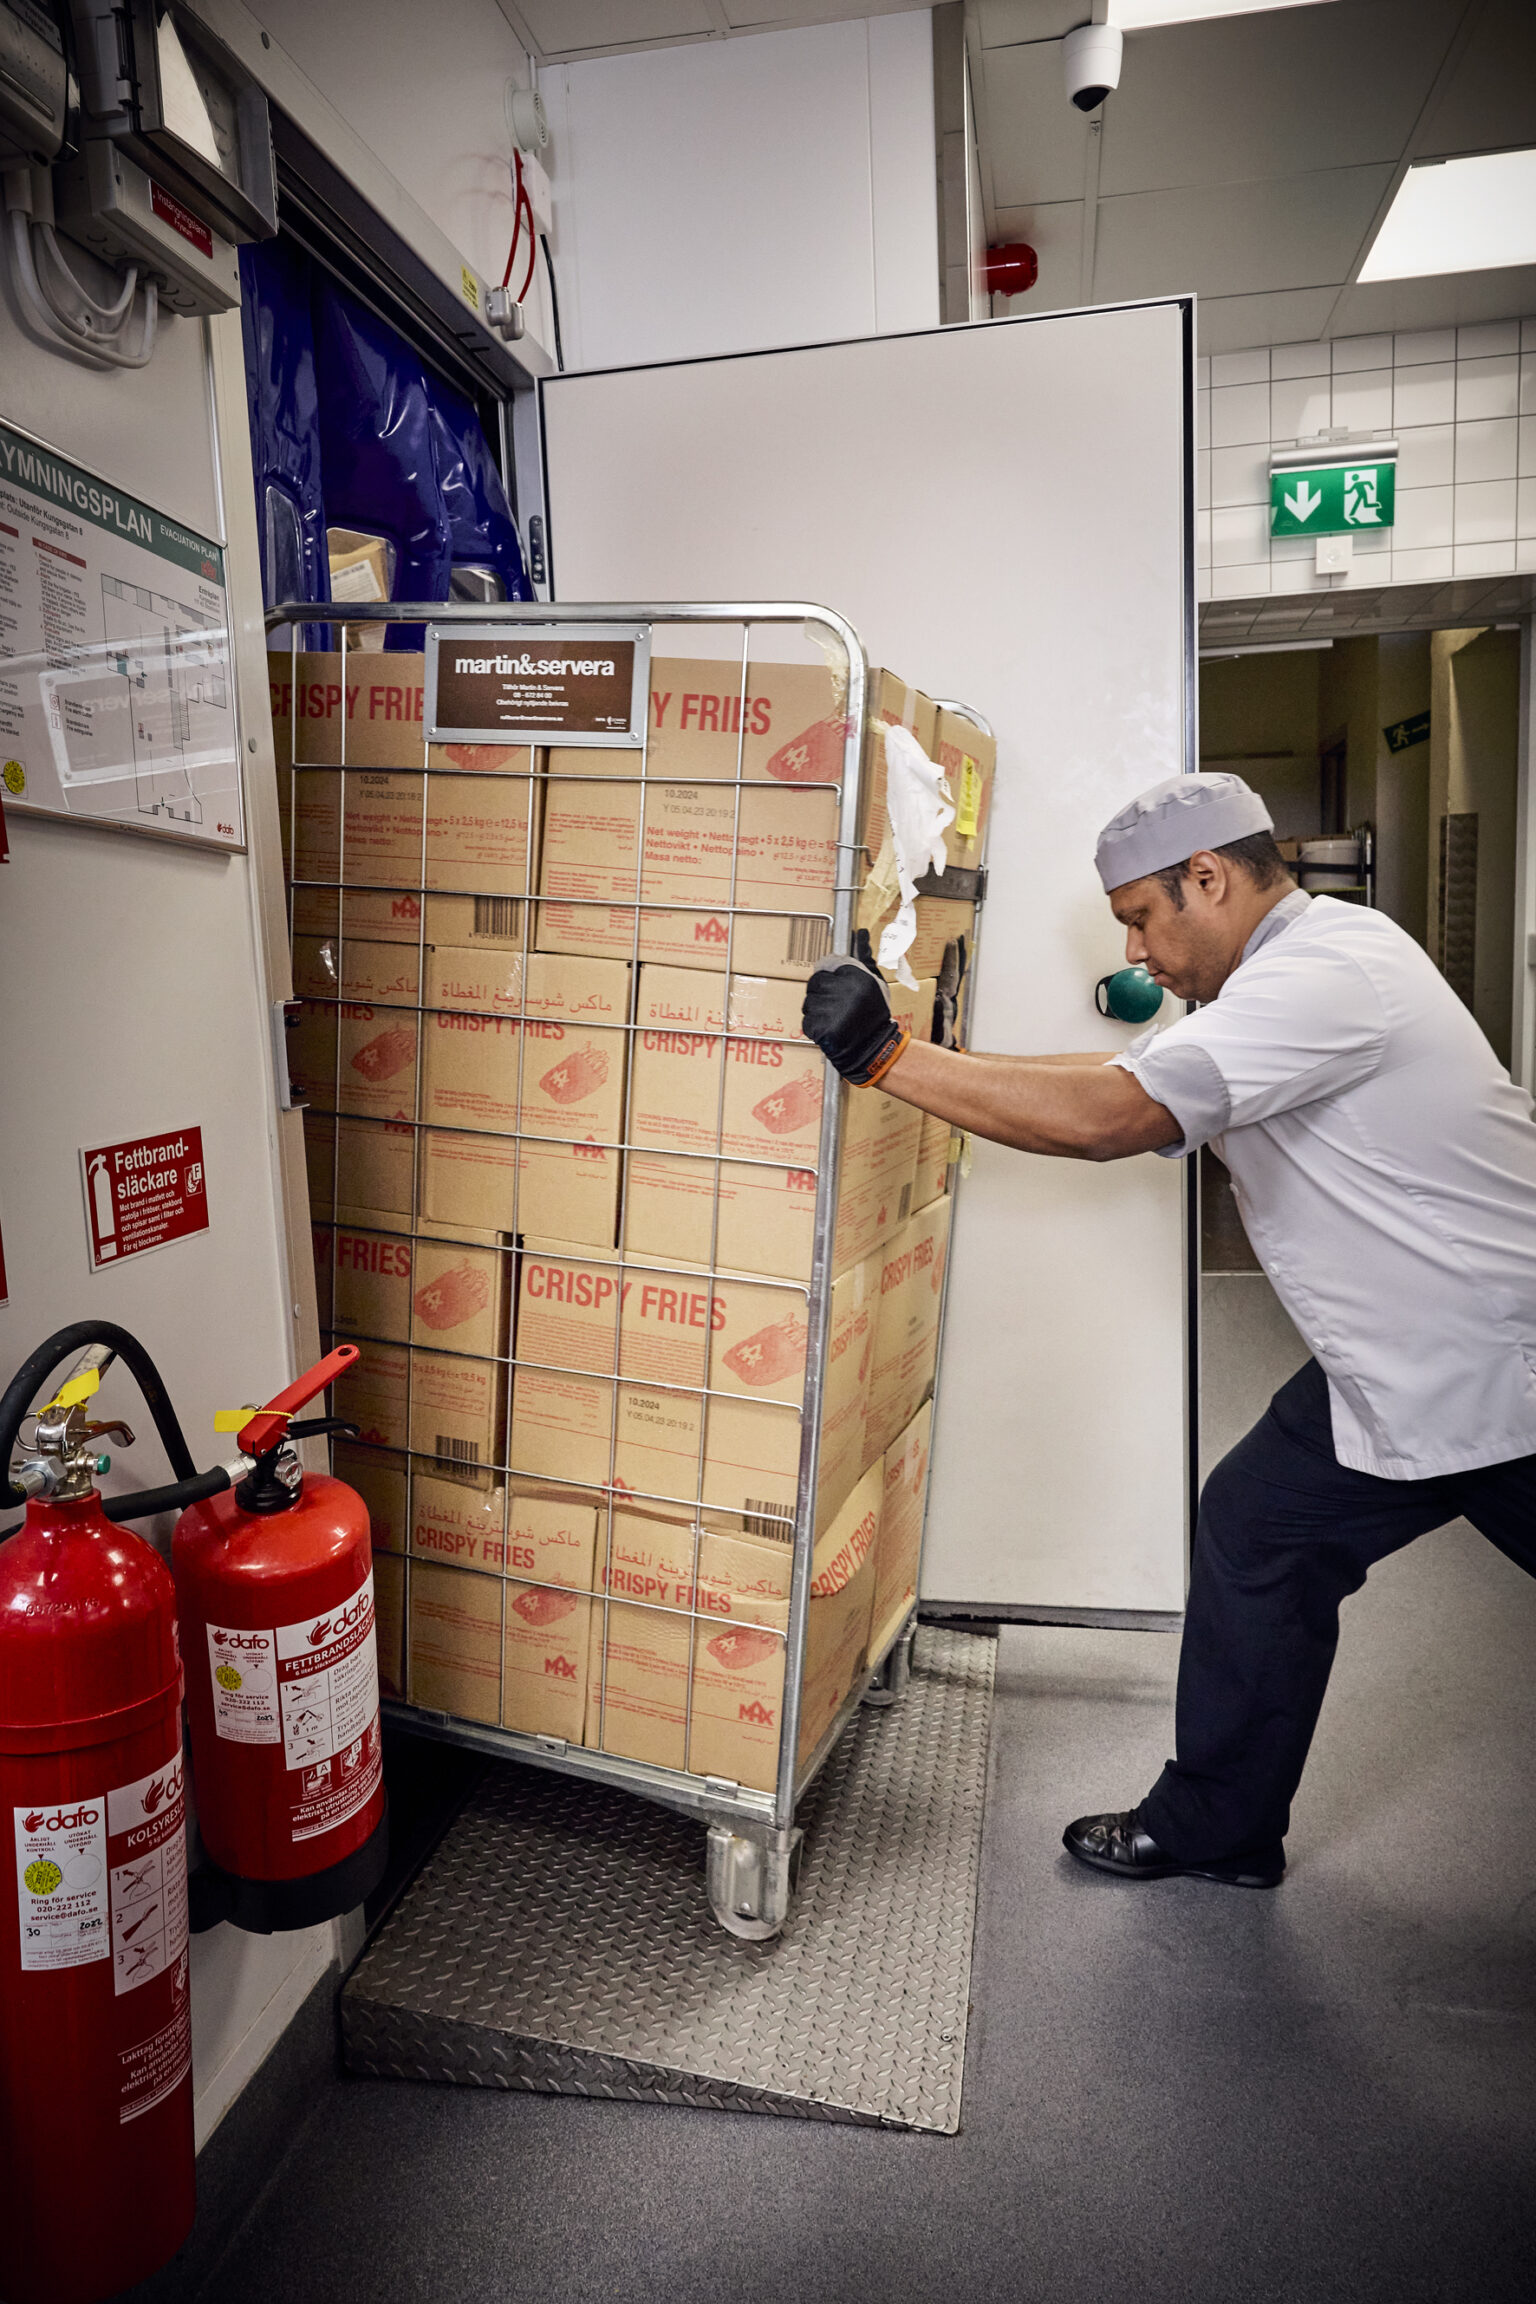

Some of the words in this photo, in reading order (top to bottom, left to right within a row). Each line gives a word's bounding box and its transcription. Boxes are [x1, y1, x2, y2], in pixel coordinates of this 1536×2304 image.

[0, 441, 152, 543] YMNINGSPLAN
[43, 509, 78, 533] Kungsgatan
[160, 524, 200, 553] EVACUATION
[201, 545, 217, 561] PLAN
[455, 653, 615, 676] martin&servera
[369, 685, 425, 722] FRIE
[680, 693, 773, 736] FRIES
[664, 789, 699, 800] 10.2024
[662, 803, 670, 813] Y
[363, 814, 391, 824] weight
[645, 838, 691, 851] Nettovikt
[646, 826, 665, 837] Net
[666, 828, 700, 841] weight
[766, 834, 773, 846] 5
[780, 835, 795, 848] 2,5
[796, 837, 807, 850] kg
[645, 851, 671, 862] Masa
[672, 854, 702, 866] netto:
[694, 916, 729, 945] MAX
[436, 1006, 504, 1034] CRISPY
[511, 1013, 566, 1041] FRIES
[643, 1030, 718, 1059] CRISPY
[725, 1037, 784, 1067] FRIES
[114, 1136, 189, 1174] Fettbrand-
[194, 1164, 200, 1179] F
[117, 1169, 178, 1200] släckare
[119, 1202, 130, 1212] Mot
[130, 1199, 146, 1209] brand
[166, 1190, 175, 1199] och
[120, 1211, 140, 1223] matolja
[162, 1197, 183, 1210] stekbord
[121, 1223, 132, 1233] och
[132, 1219, 148, 1231] spisar
[148, 1214, 160, 1224] samt
[163, 1209, 175, 1219] filter
[175, 1206, 185, 1216] och
[123, 1243, 132, 1253] Får
[132, 1241, 139, 1251] ej
[337, 1237, 411, 1278] FRIES
[526, 1264, 633, 1313] CRISPY
[640, 1284, 728, 1331] FRIES
[628, 1397, 661, 1411] 10.2024
[689, 1422, 696, 1432] 2
[415, 1524, 478, 1558] CRISPY
[482, 1540, 536, 1570] FRIES
[601, 1565, 670, 1601] CRISPY
[675, 1584, 732, 1614] FRIES
[333, 1592, 369, 1635] dafo
[229, 1633, 270, 1650] dafo
[544, 1655, 578, 1680] MAX
[285, 1714, 292, 1722] 2
[738, 1699, 776, 1727] MAX
[319, 1764, 329, 1774] A
[46, 1805, 99, 1832] dafo
[292, 1806, 325, 1822] elektrisk
[300, 1804, 315, 1814] Kan
[320, 1811, 331, 1821] på
[331, 1808, 340, 1816] en
[115, 1871, 121, 1881] 1
[31, 1897, 50, 1906] Ring
[51, 1896, 64, 1904] för
[66, 1890, 97, 1901] service
[36, 1903, 73, 1913] 020-222
[75, 1899, 92, 1908] 112
[31, 1905, 98, 1921] service@dafo.se
[116, 1913, 123, 1923] 2
[26, 1927, 41, 1937] 30
[117, 1955, 124, 1965] 3
[130, 2066, 148, 2079] Kan
